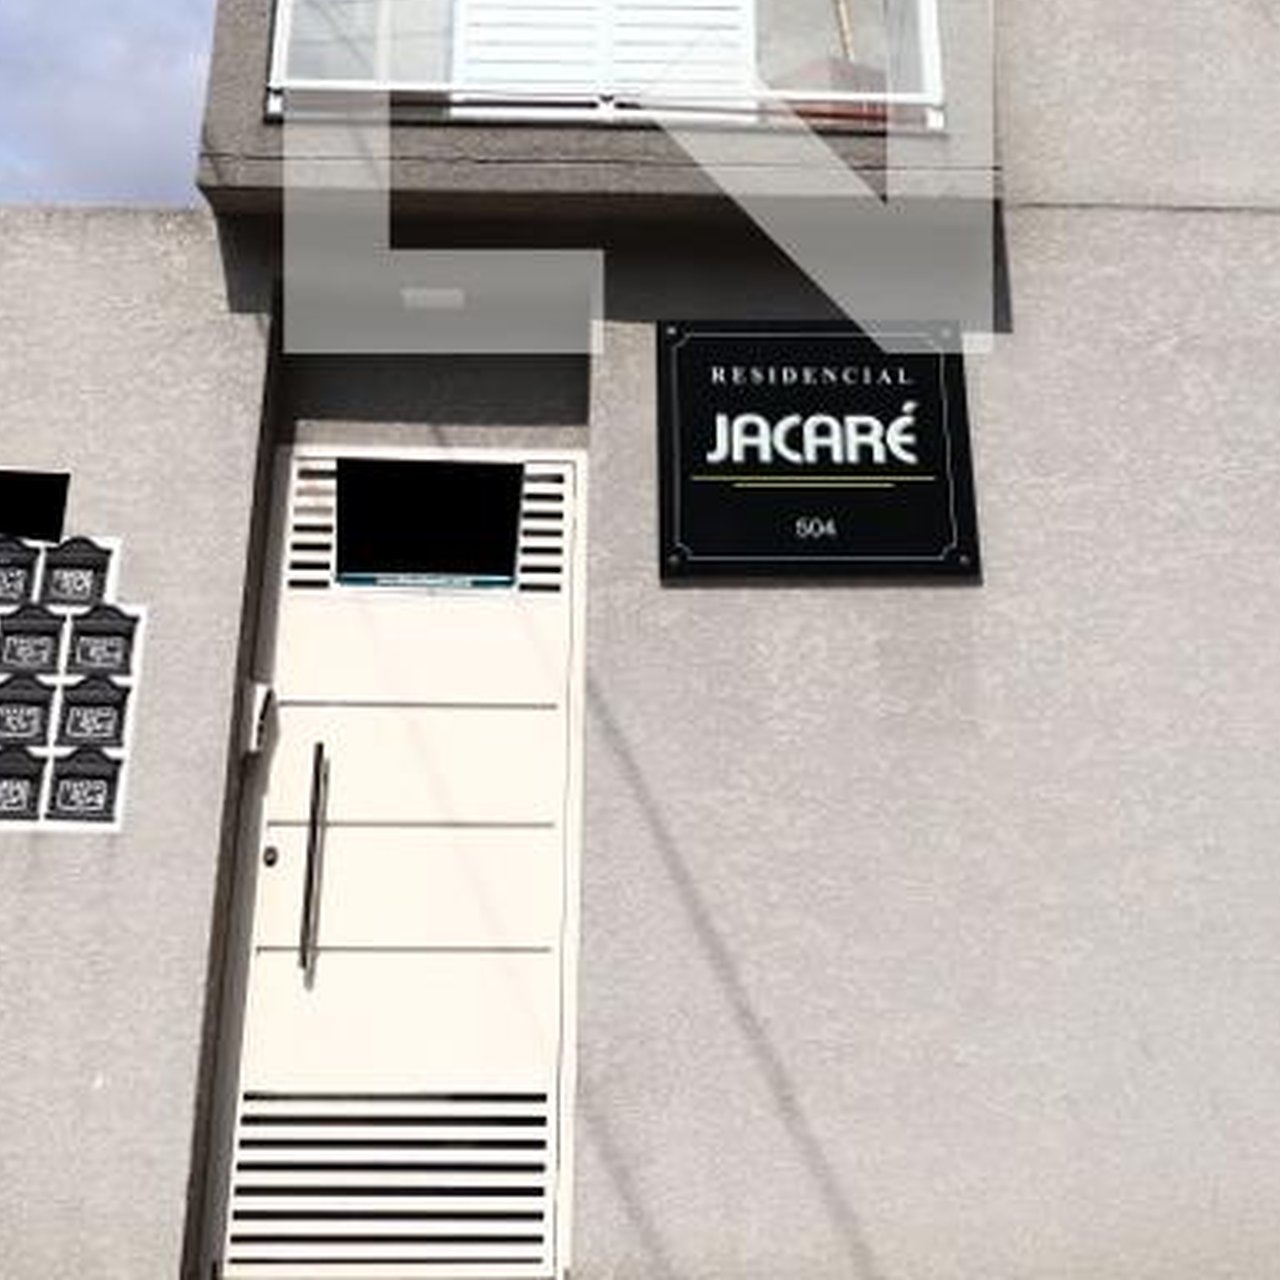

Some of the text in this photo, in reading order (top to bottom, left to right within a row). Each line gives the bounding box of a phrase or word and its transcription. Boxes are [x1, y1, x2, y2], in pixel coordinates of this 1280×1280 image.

[711, 366, 914, 385] RESIDENCIAL
[706, 401, 918, 464] JACARÉ
[795, 517, 837, 539] 504
